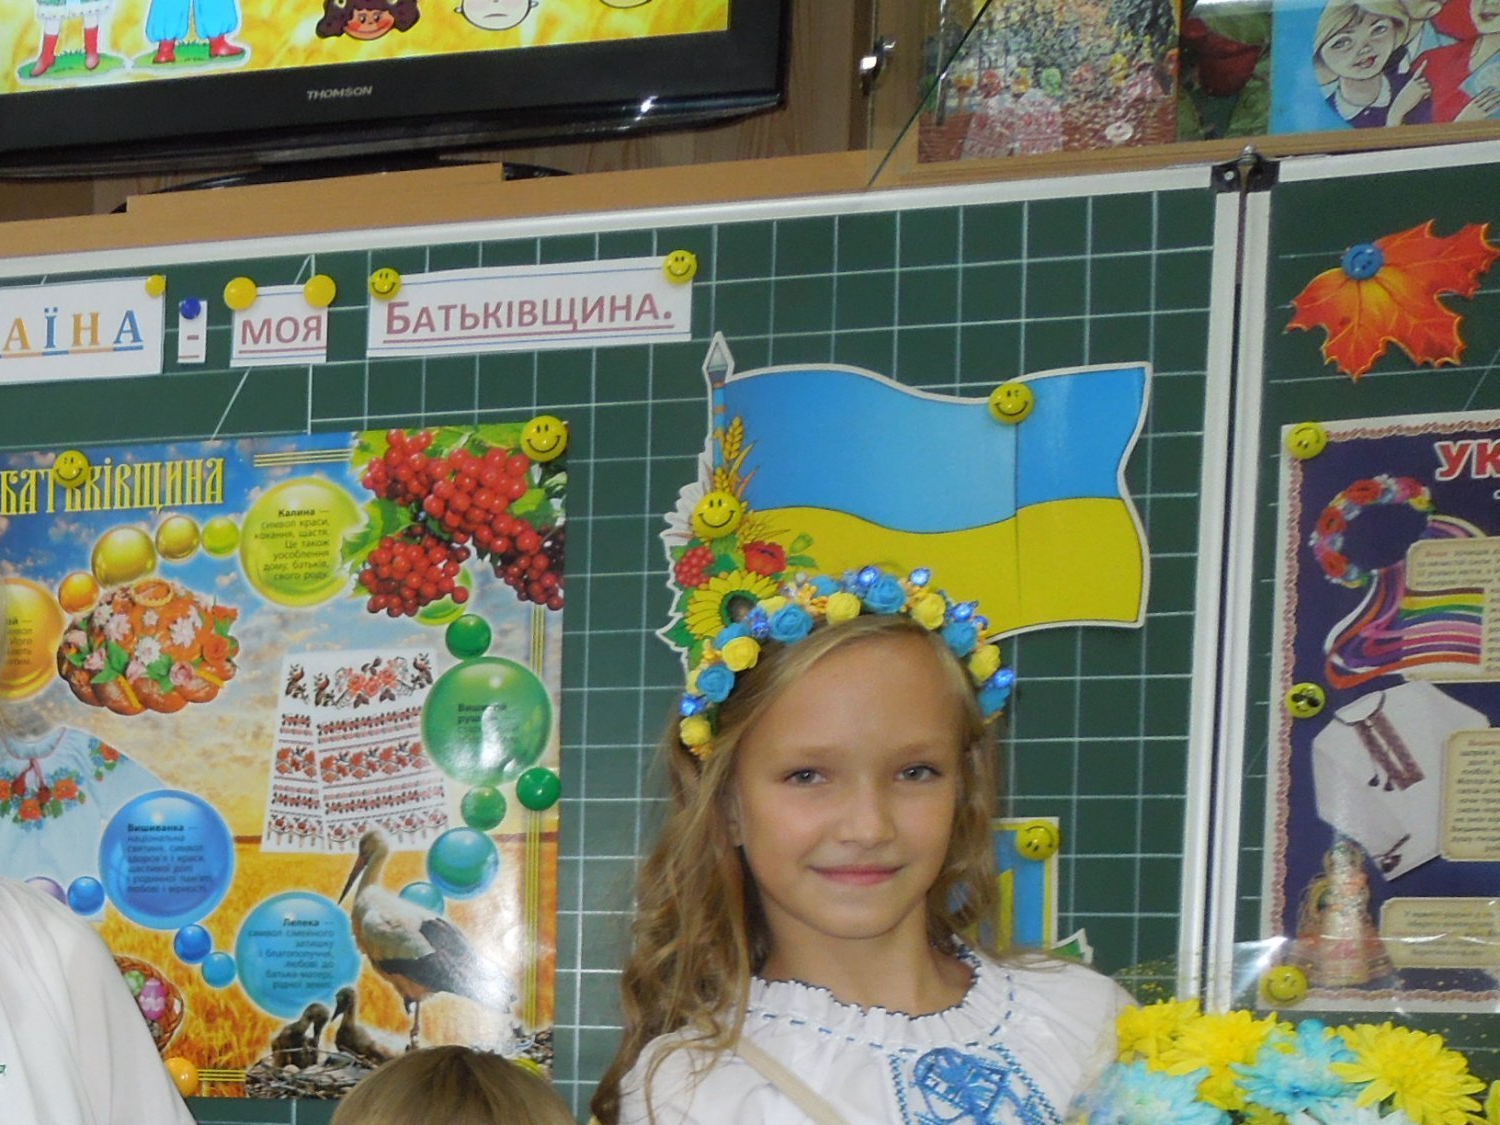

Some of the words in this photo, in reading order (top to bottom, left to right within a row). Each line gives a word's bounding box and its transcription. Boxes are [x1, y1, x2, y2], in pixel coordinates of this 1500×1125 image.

[307, 85, 373, 100] THOMSON
[278, 508, 316, 518] Калина
[261, 521, 296, 530] символ
[128, 823, 184, 832] Вишиванка
[283, 918, 320, 927] Лелека
